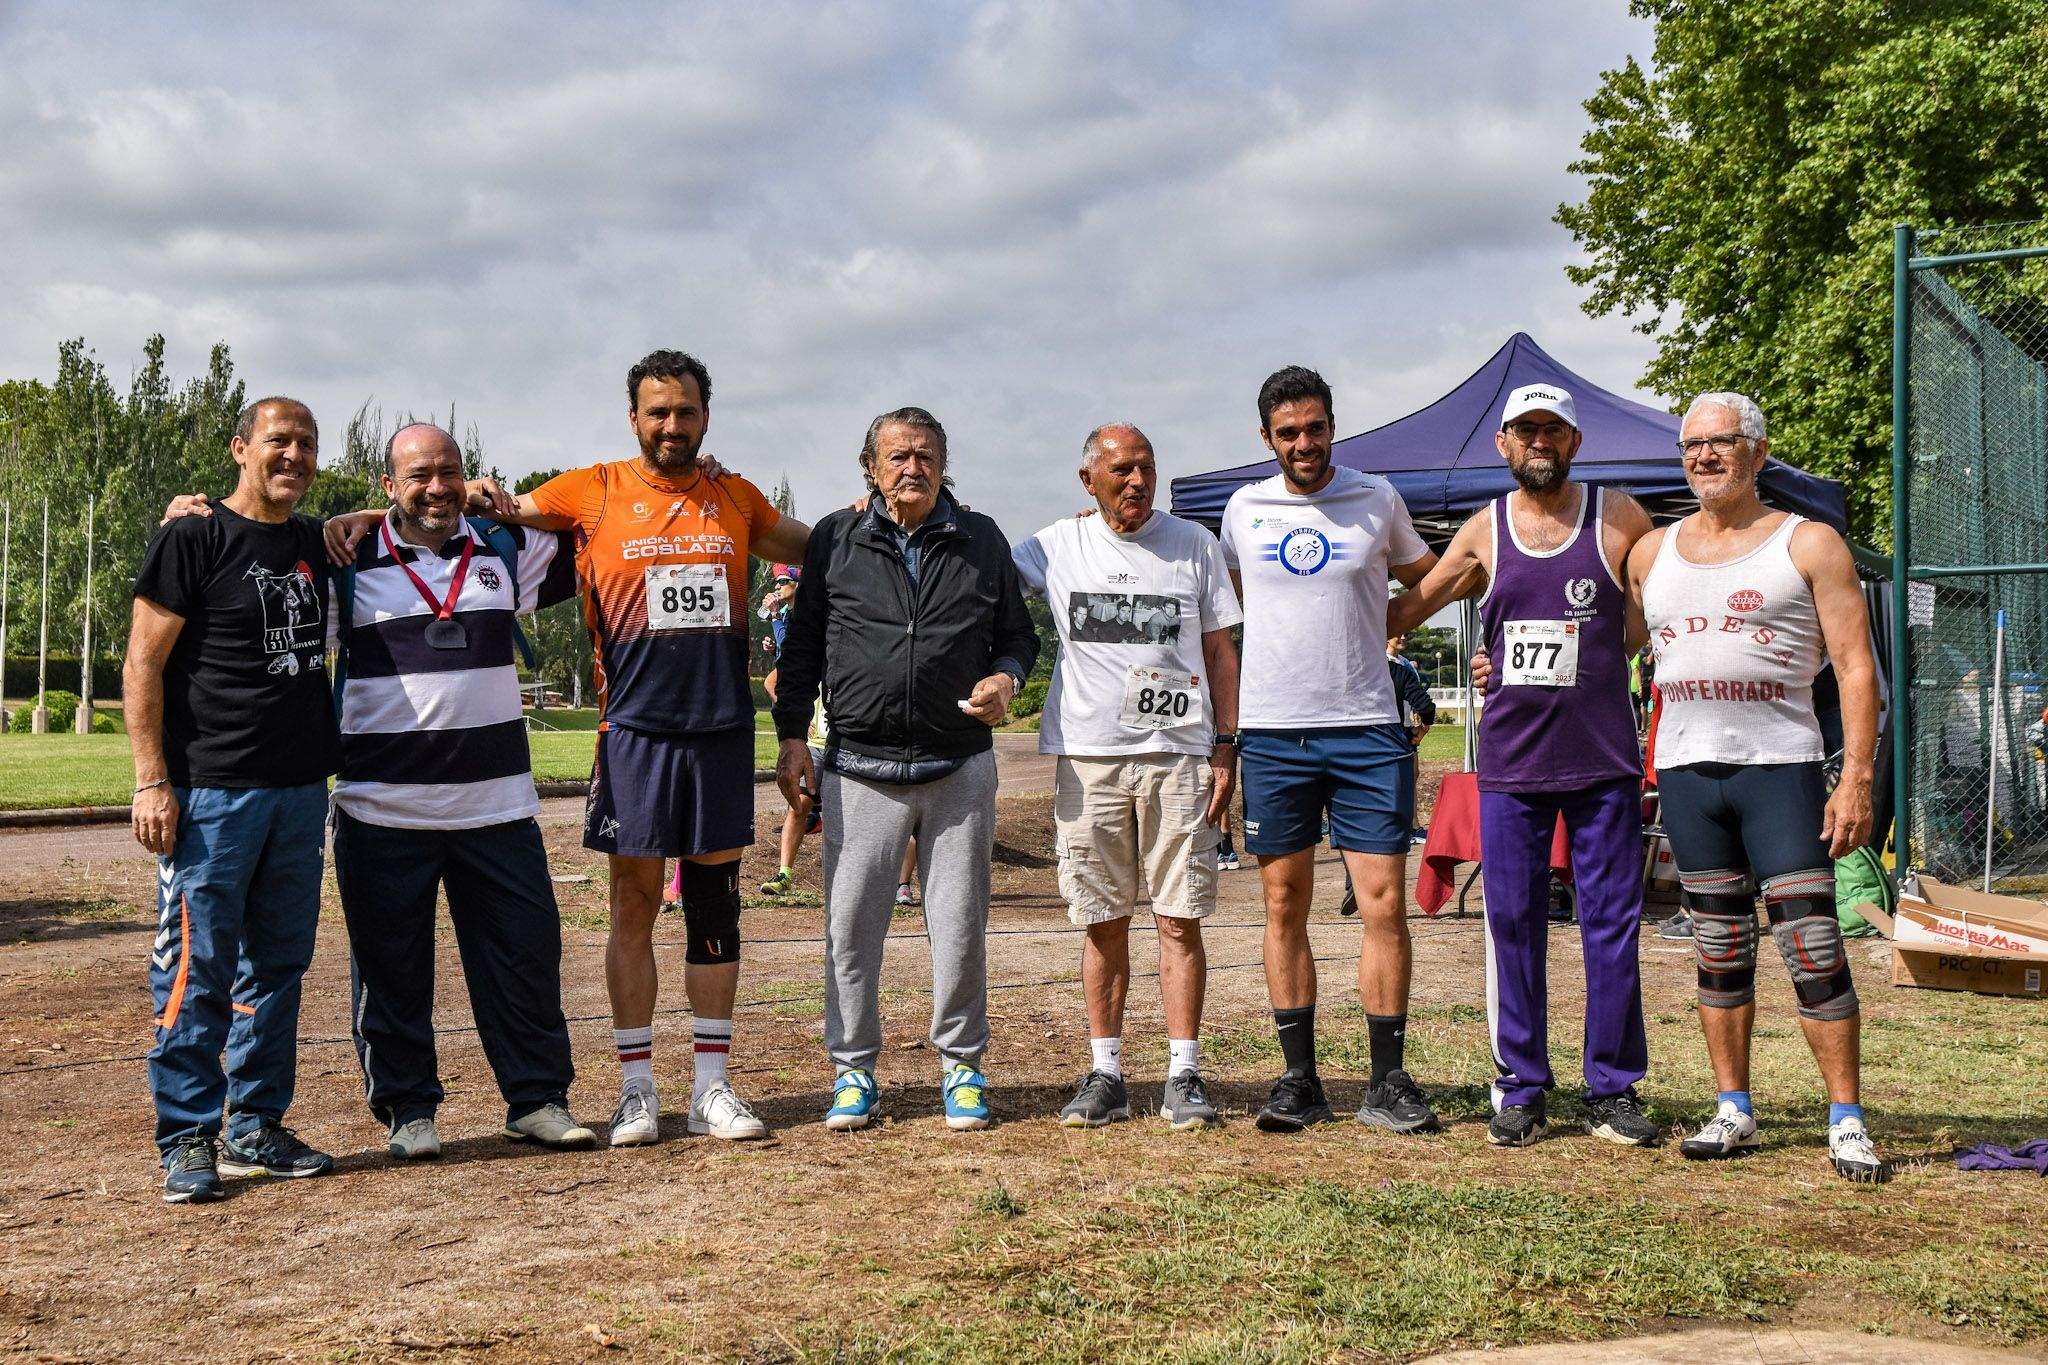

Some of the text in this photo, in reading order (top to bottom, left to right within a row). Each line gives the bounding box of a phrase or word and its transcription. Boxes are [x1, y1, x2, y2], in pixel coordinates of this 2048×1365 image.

[621, 533, 735, 548] UNIÓN ATLÉTICA
[623, 543, 735, 560] COSLADA
[662, 586, 715, 613] 895
[270, 641, 283, 650] 31
[1512, 642, 1563, 669] 877
[1660, 680, 1786, 702] PONFERRADA
[1138, 687, 1189, 718] 820
[1838, 1132, 1864, 1143] NIKE
